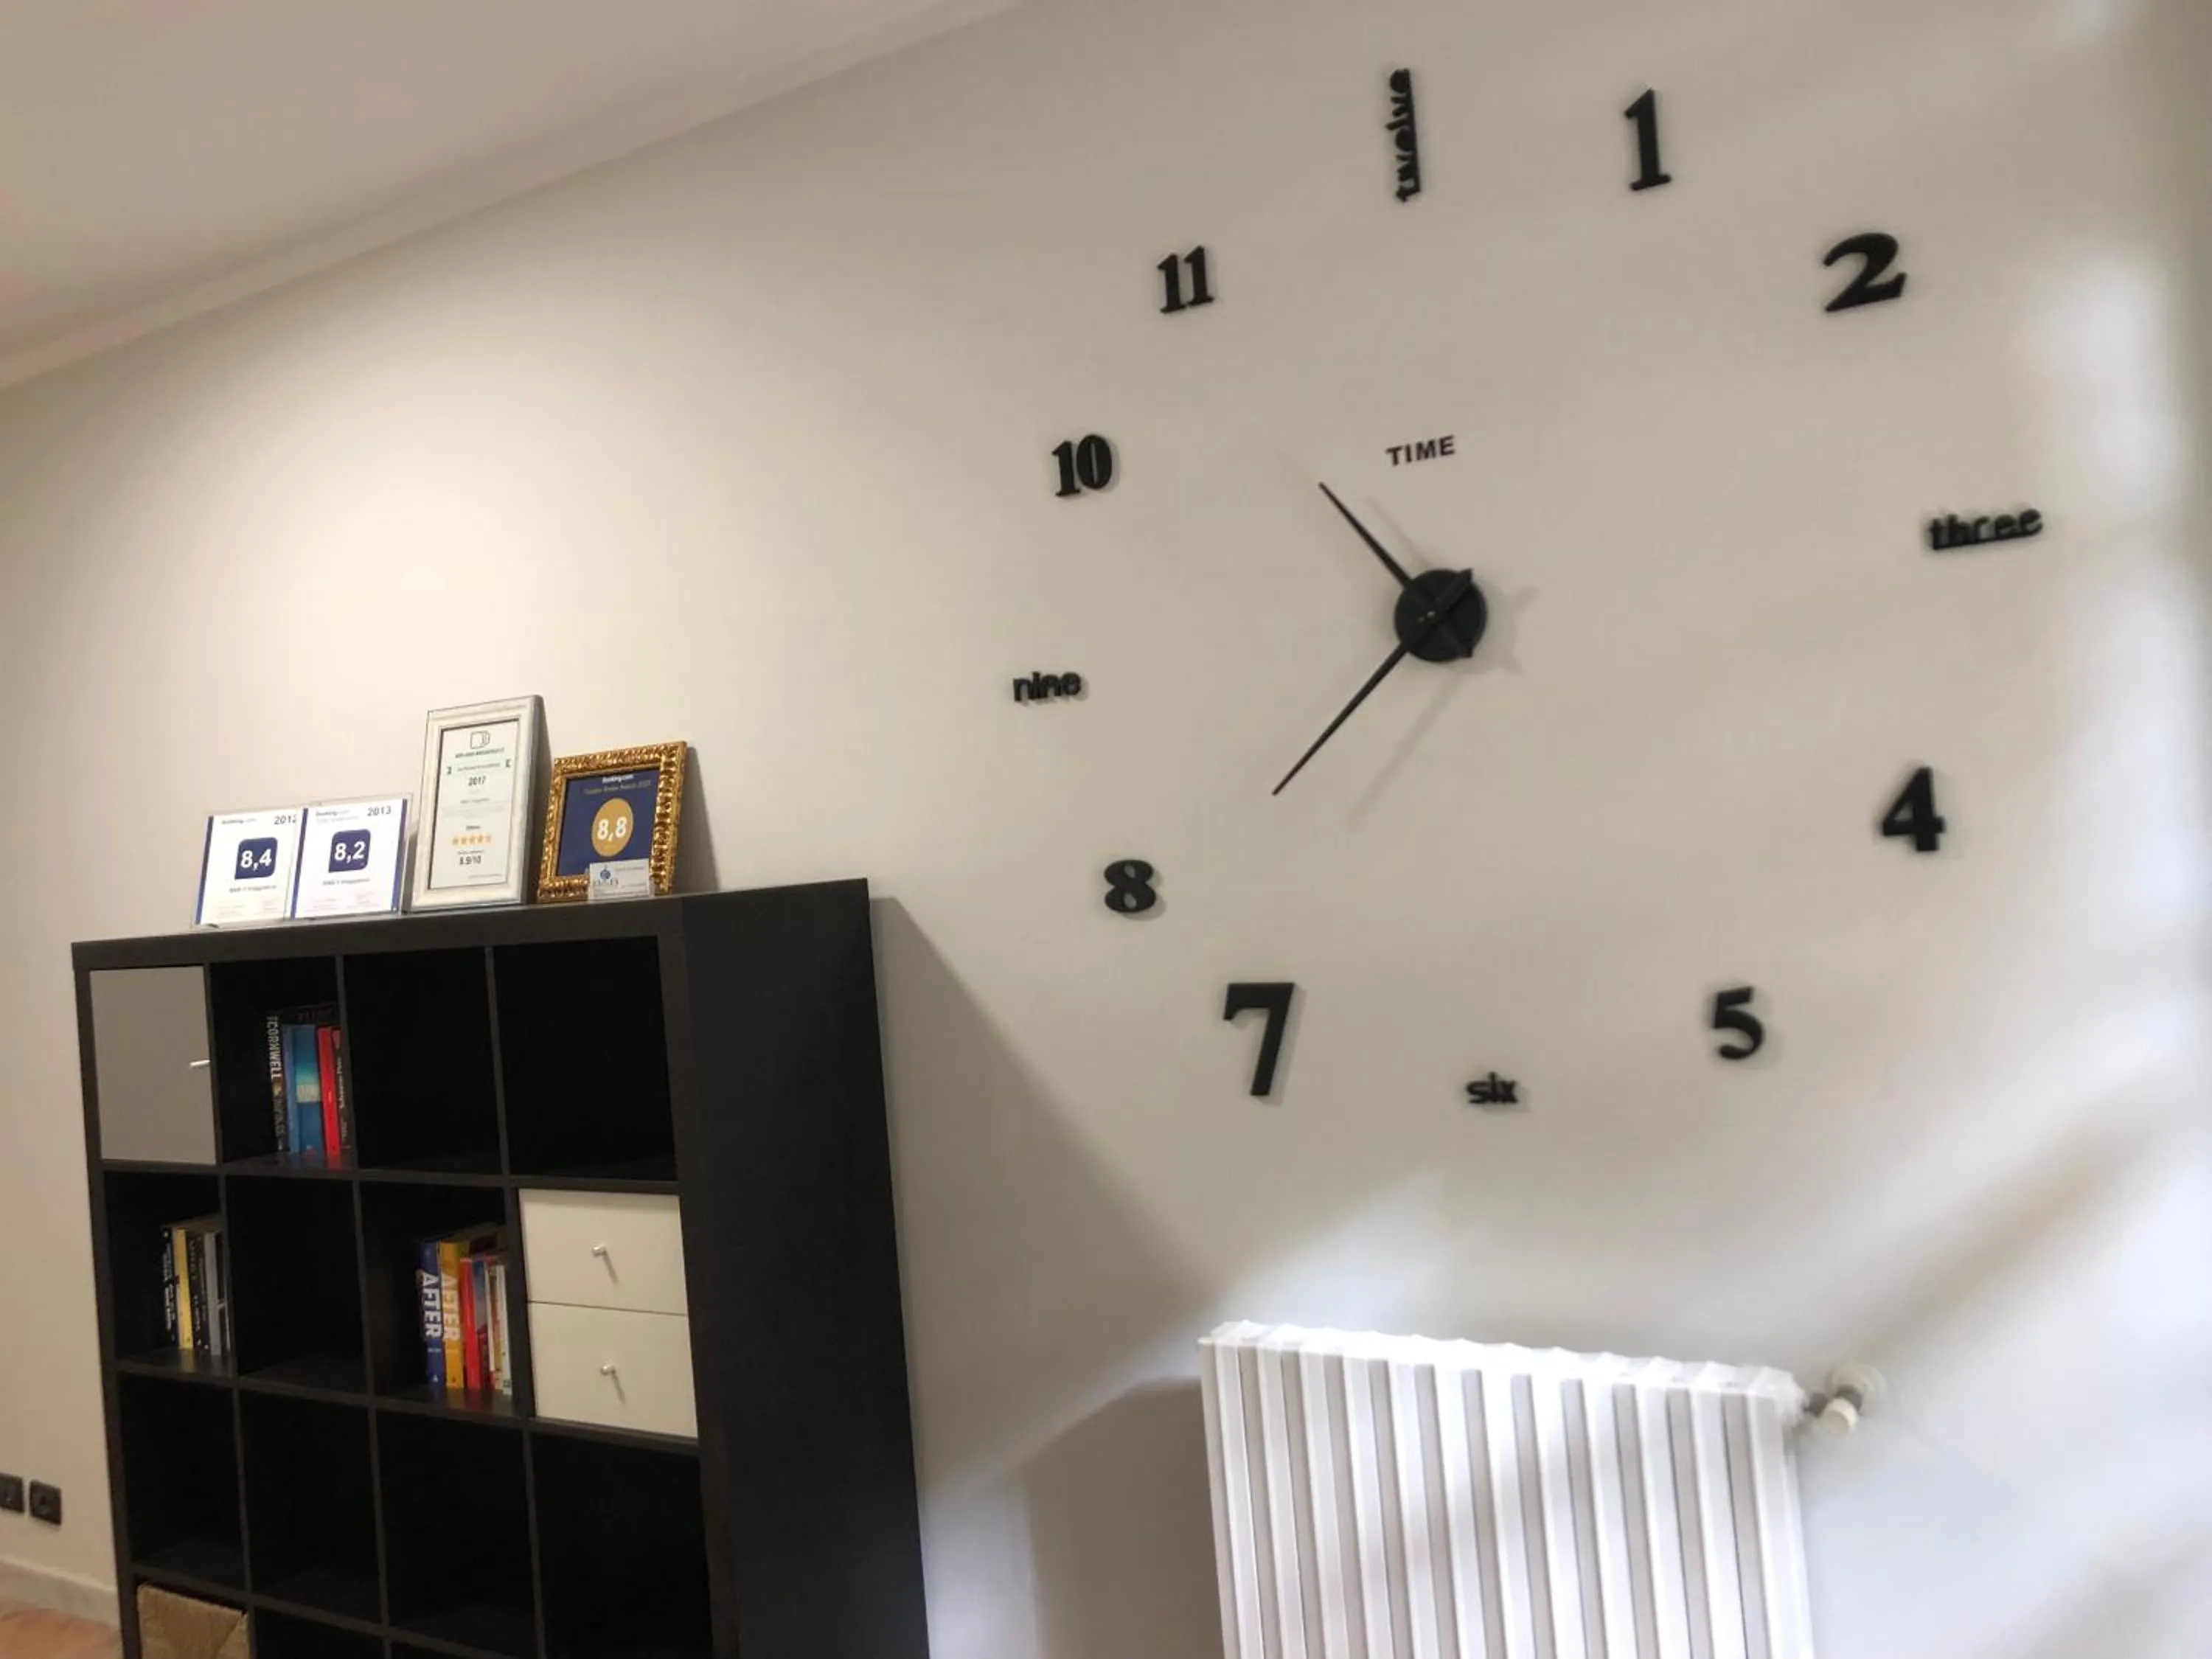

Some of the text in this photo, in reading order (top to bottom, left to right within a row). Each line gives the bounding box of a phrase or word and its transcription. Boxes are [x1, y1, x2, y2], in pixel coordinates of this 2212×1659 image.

[1385, 68, 1422, 203] twelve
[1624, 89, 1672, 192] 1
[1157, 246, 1214, 314] 11
[1823, 233, 1906, 313] 2
[1052, 434, 1113, 497] 10
[1386, 436, 1455, 466] TIME
[1928, 509, 2043, 550] three
[1013, 671, 1082, 702] nine
[597, 816, 627, 842] 8,8
[1881, 768, 1944, 852] 4
[240, 849, 272, 872] 8,4
[334, 840, 366, 863] 8,2
[1103, 860, 1158, 914] 8
[1223, 982, 1295, 1097] 7
[1712, 987, 1764, 1060] 5
[1467, 1072, 1519, 1104] six
[422, 1272, 443, 1338] AFTER
[442, 1273, 462, 1342] AFTER
